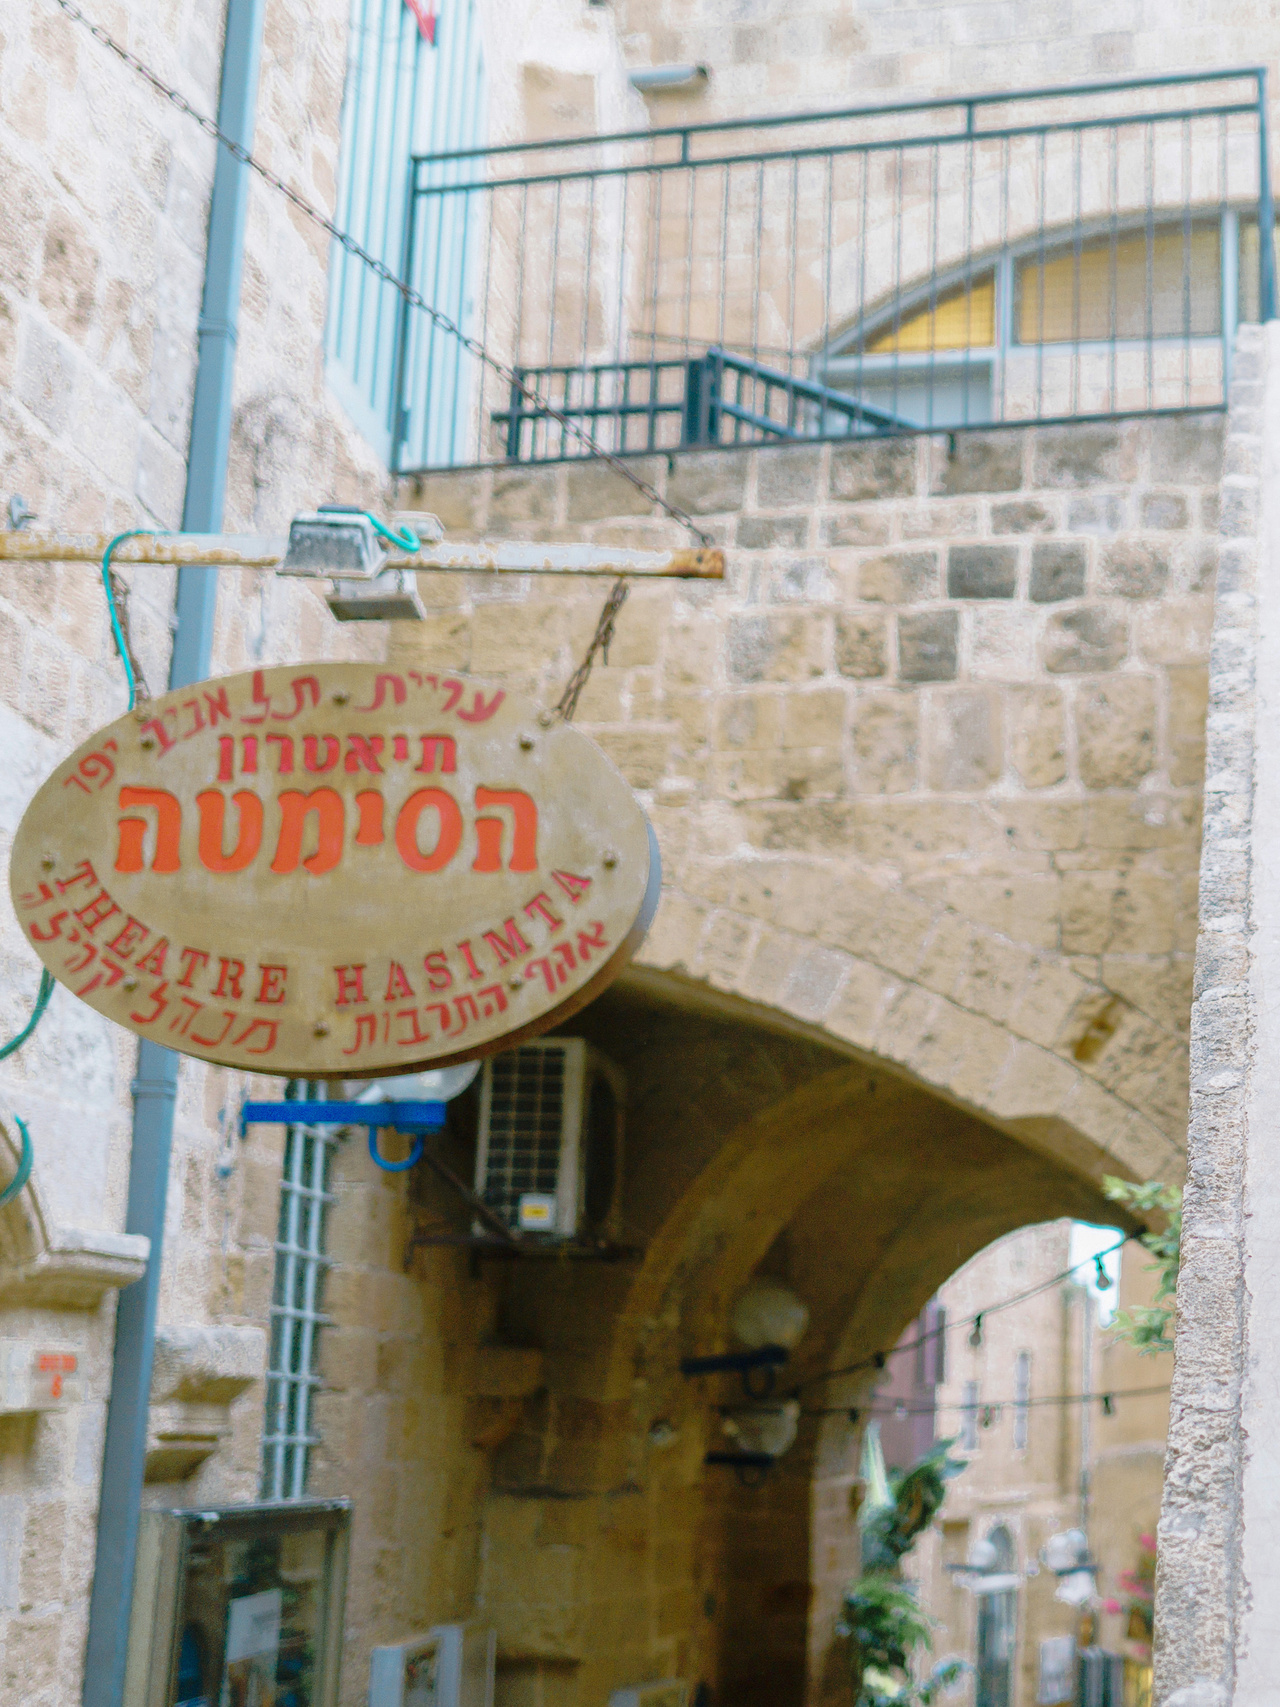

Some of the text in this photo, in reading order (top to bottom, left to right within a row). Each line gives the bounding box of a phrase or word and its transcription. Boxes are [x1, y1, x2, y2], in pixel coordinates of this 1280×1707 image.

[140, 687, 232, 757] אביב
[241, 670, 321, 725] תל
[62, 737, 118, 794] יפו
[217, 733, 457, 783] תיאטרון
[114, 785, 539, 876] הסימטה
[56, 858, 593, 1006] THEATRE HASIMTA
[129, 981, 282, 1055] מנהל
[341, 981, 510, 1056] התרבות
